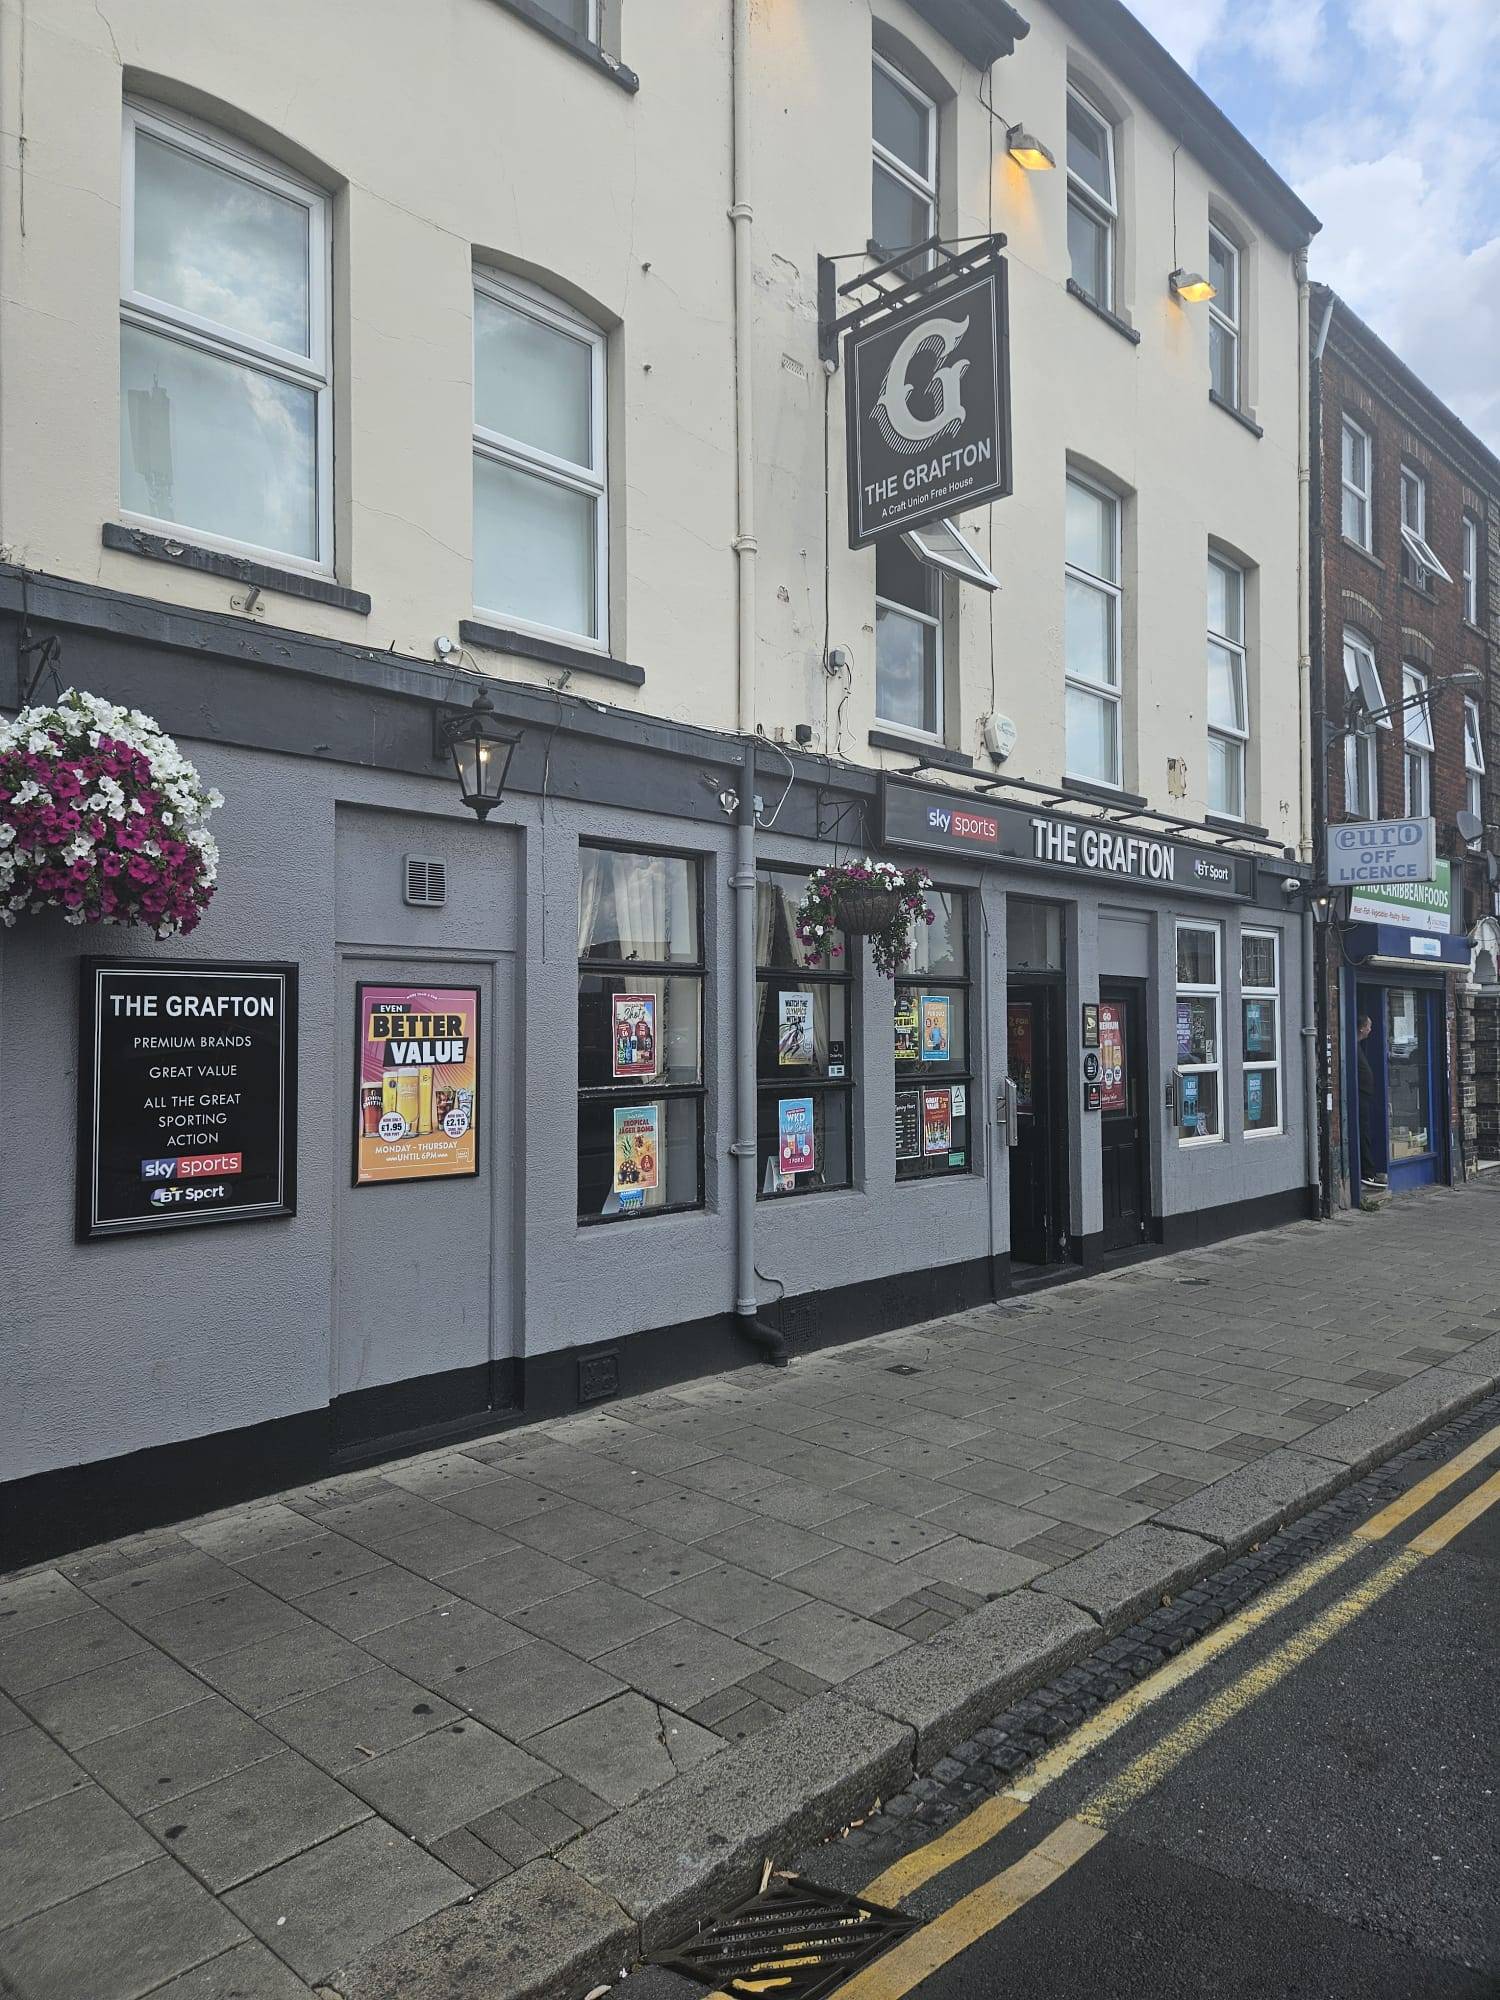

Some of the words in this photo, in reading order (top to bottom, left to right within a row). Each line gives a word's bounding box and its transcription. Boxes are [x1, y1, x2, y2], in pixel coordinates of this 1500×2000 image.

[871, 314, 971, 447] G
[865, 475, 898, 505] THE
[903, 438, 991, 490] GRAFTON
[881, 508, 889, 518] A
[890, 500, 906, 515] Craft
[907, 494, 929, 512] Union
[930, 487, 948, 502] Free
[949, 476, 974, 493] House
[929, 808, 951, 833] sky
[954, 815, 996, 838] sports
[1340, 823, 1422, 848] euro
[1031, 818, 1078, 863] THE
[1082, 829, 1175, 881] GRAFTON
[1360, 850, 1397, 865] OFF
[1197, 860, 1209, 877] BT
[1209, 864, 1228, 881] Sport
[1340, 864, 1417, 881] LICENCE
[1381, 883, 1424, 903] CARIBBEAN
[1424, 886, 1449, 908] FOODS
[110, 995, 158, 1017] THE
[166, 996, 274, 1017] GRAFTON
[380, 1005, 402, 1013] EVEN
[373, 1015, 462, 1037] BETTER
[134, 1037, 195, 1049] PREMIUM
[200, 1036, 252, 1047] BRANDS
[390, 1040, 464, 1065] VALUE
[149, 1066, 193, 1078] GREAT
[197, 1065, 238, 1077] VALUE
[144, 1098, 166, 1108] ALL
[172, 1096, 195, 1107] THE
[200, 1093, 241, 1106] GREAT
[158, 1113, 227, 1127] SPORTING
[446, 1118, 466, 1127] £2.15
[624, 1119, 649, 1127] TROPICAL
[787, 1112, 806, 1122] WKD
[381, 1122, 402, 1132] £1.95
[637, 1125, 654, 1133] BOMB
[167, 1133, 218, 1147] ACTION
[375, 1145, 411, 1154] MONDAY
[418, 1141, 458, 1150] THURSDAY
[398, 1153, 420, 1161] UNTIL
[421, 1151, 437, 1159] 6PM
[145, 1161, 175, 1178] sky
[181, 1154, 238, 1176] sports
[160, 1186, 184, 1203] BT
[185, 1184, 224, 1201] Sport
